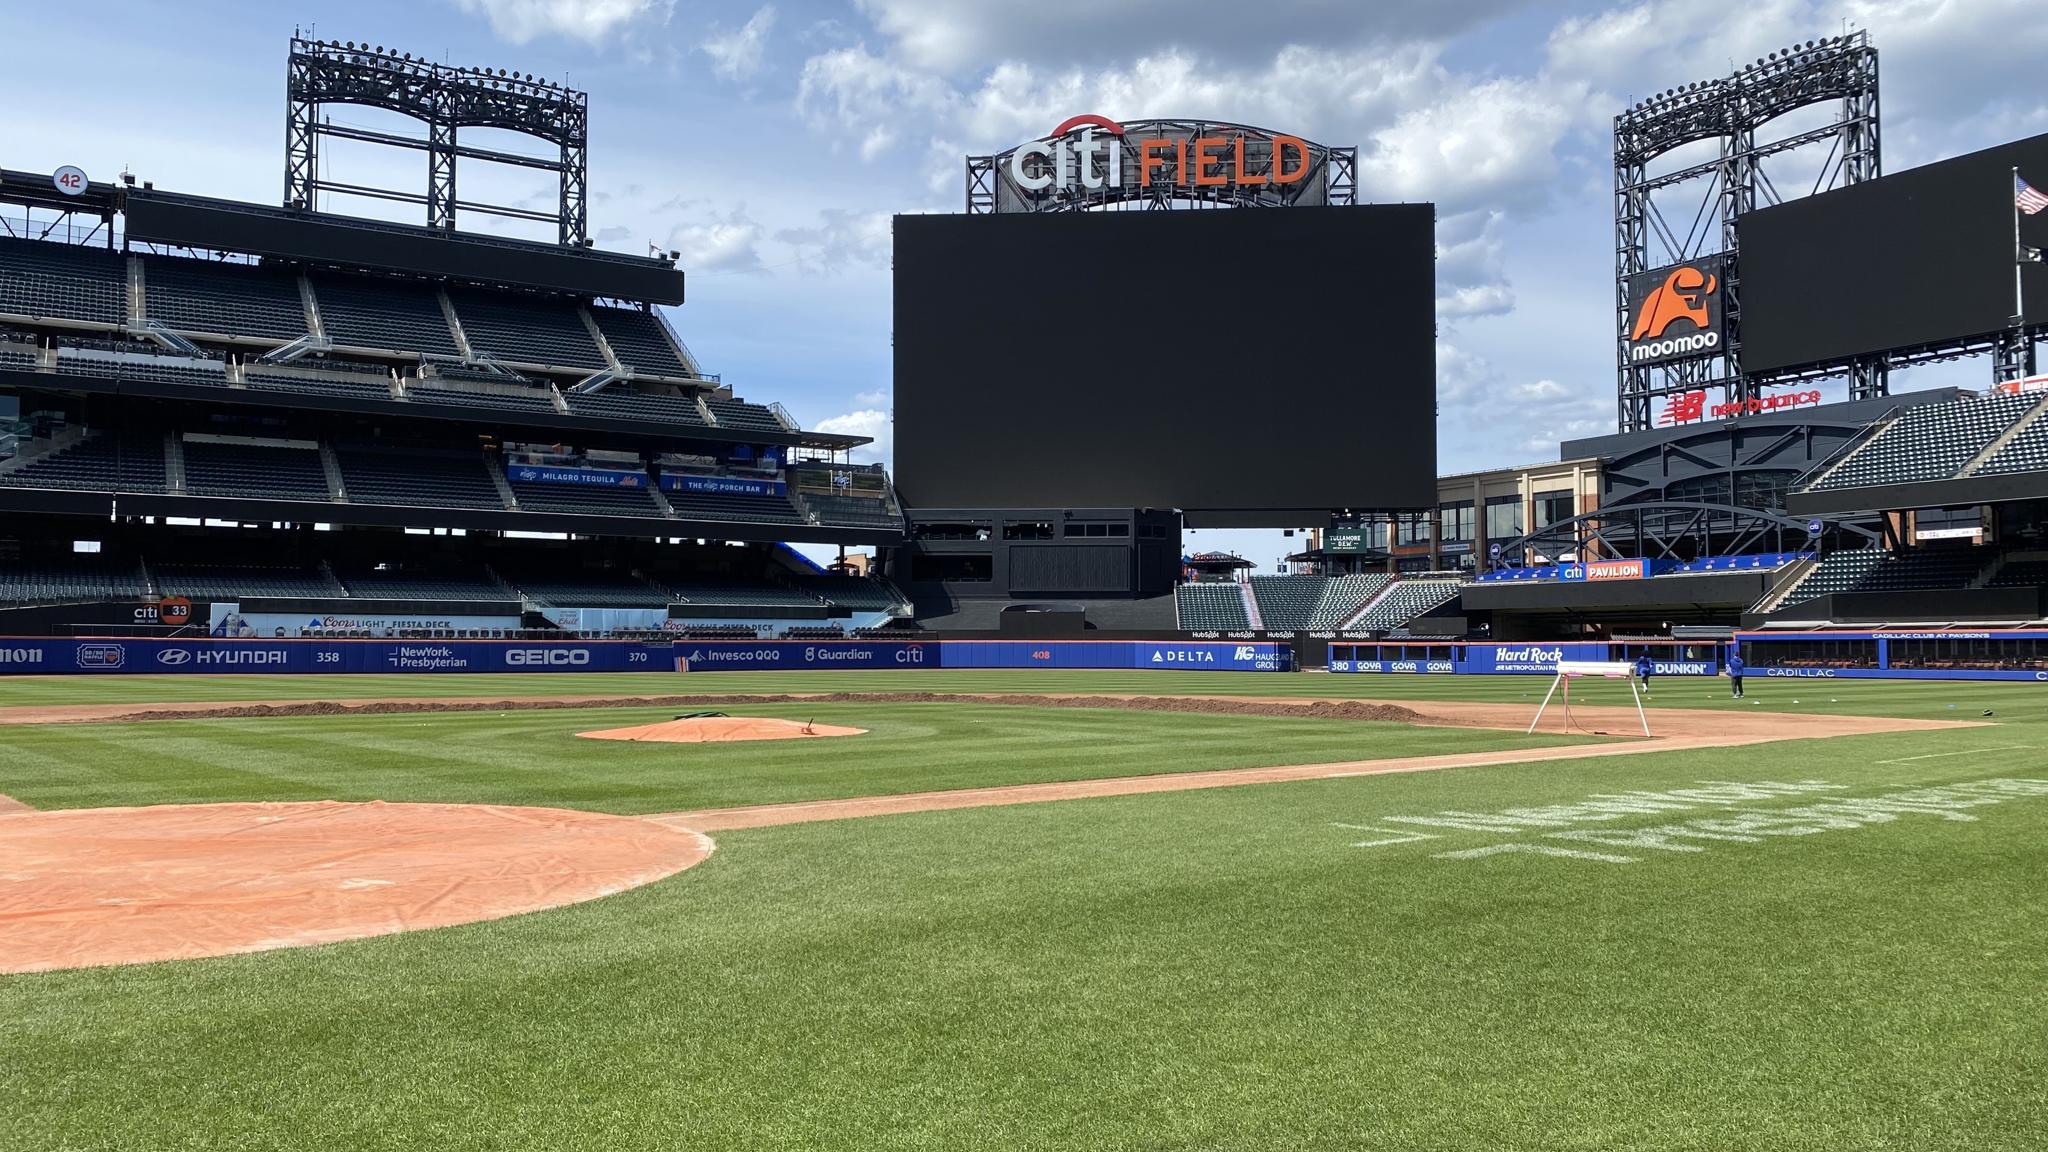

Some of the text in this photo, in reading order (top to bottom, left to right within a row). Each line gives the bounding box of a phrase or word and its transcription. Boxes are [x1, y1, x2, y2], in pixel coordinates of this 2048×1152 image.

[1011, 127, 1310, 190] citi FIELD
[60, 173, 81, 188] 42
[1633, 331, 1719, 361] moomoo
[1710, 390, 1822, 417] new balance
[542, 473, 579, 481] MILAGRO
[581, 475, 615, 483] TEQUILA
[719, 484, 744, 492] PORCH
[1564, 566, 1583, 579] citi
[1589, 566, 1639, 578] PAVILION
[134, 606, 158, 618] citi
[172, 605, 187, 616] 33
[356, 620, 385, 628] LIGHT
[392, 621, 422, 629] FIESTA
[1192, 631, 1220, 639] HubSpot
[1228, 631, 1255, 639] HubSpot
[1267, 631, 1295, 639] HubSpot
[0, 649, 43, 662] non
[197, 651, 287, 663] HYUNDAI
[316, 652, 340, 662] 358
[401, 647, 453, 657] NewYork-
[505, 649, 590, 665] GEICO
[629, 652, 647, 662] 370
[708, 650, 780, 661] Invesco QQQ
[818, 648, 872, 660] Guardian
[895, 647, 923, 662] citi
[1032, 651, 1051, 660] 408
[1167, 651, 1214, 662] DELTA
[1496, 647, 1563, 664] Hard Rock
[401, 657, 467, 669] Presbyterian
[1332, 662, 1349, 671] 380
[1357, 662, 1382, 670] GOYA
[1391, 662, 1417, 670] GOYA
[1427, 662, 1453, 671] GOYA
[1655, 663, 1707, 674] DUNKIN'
[1767, 669, 1835, 677] CADILLAC
